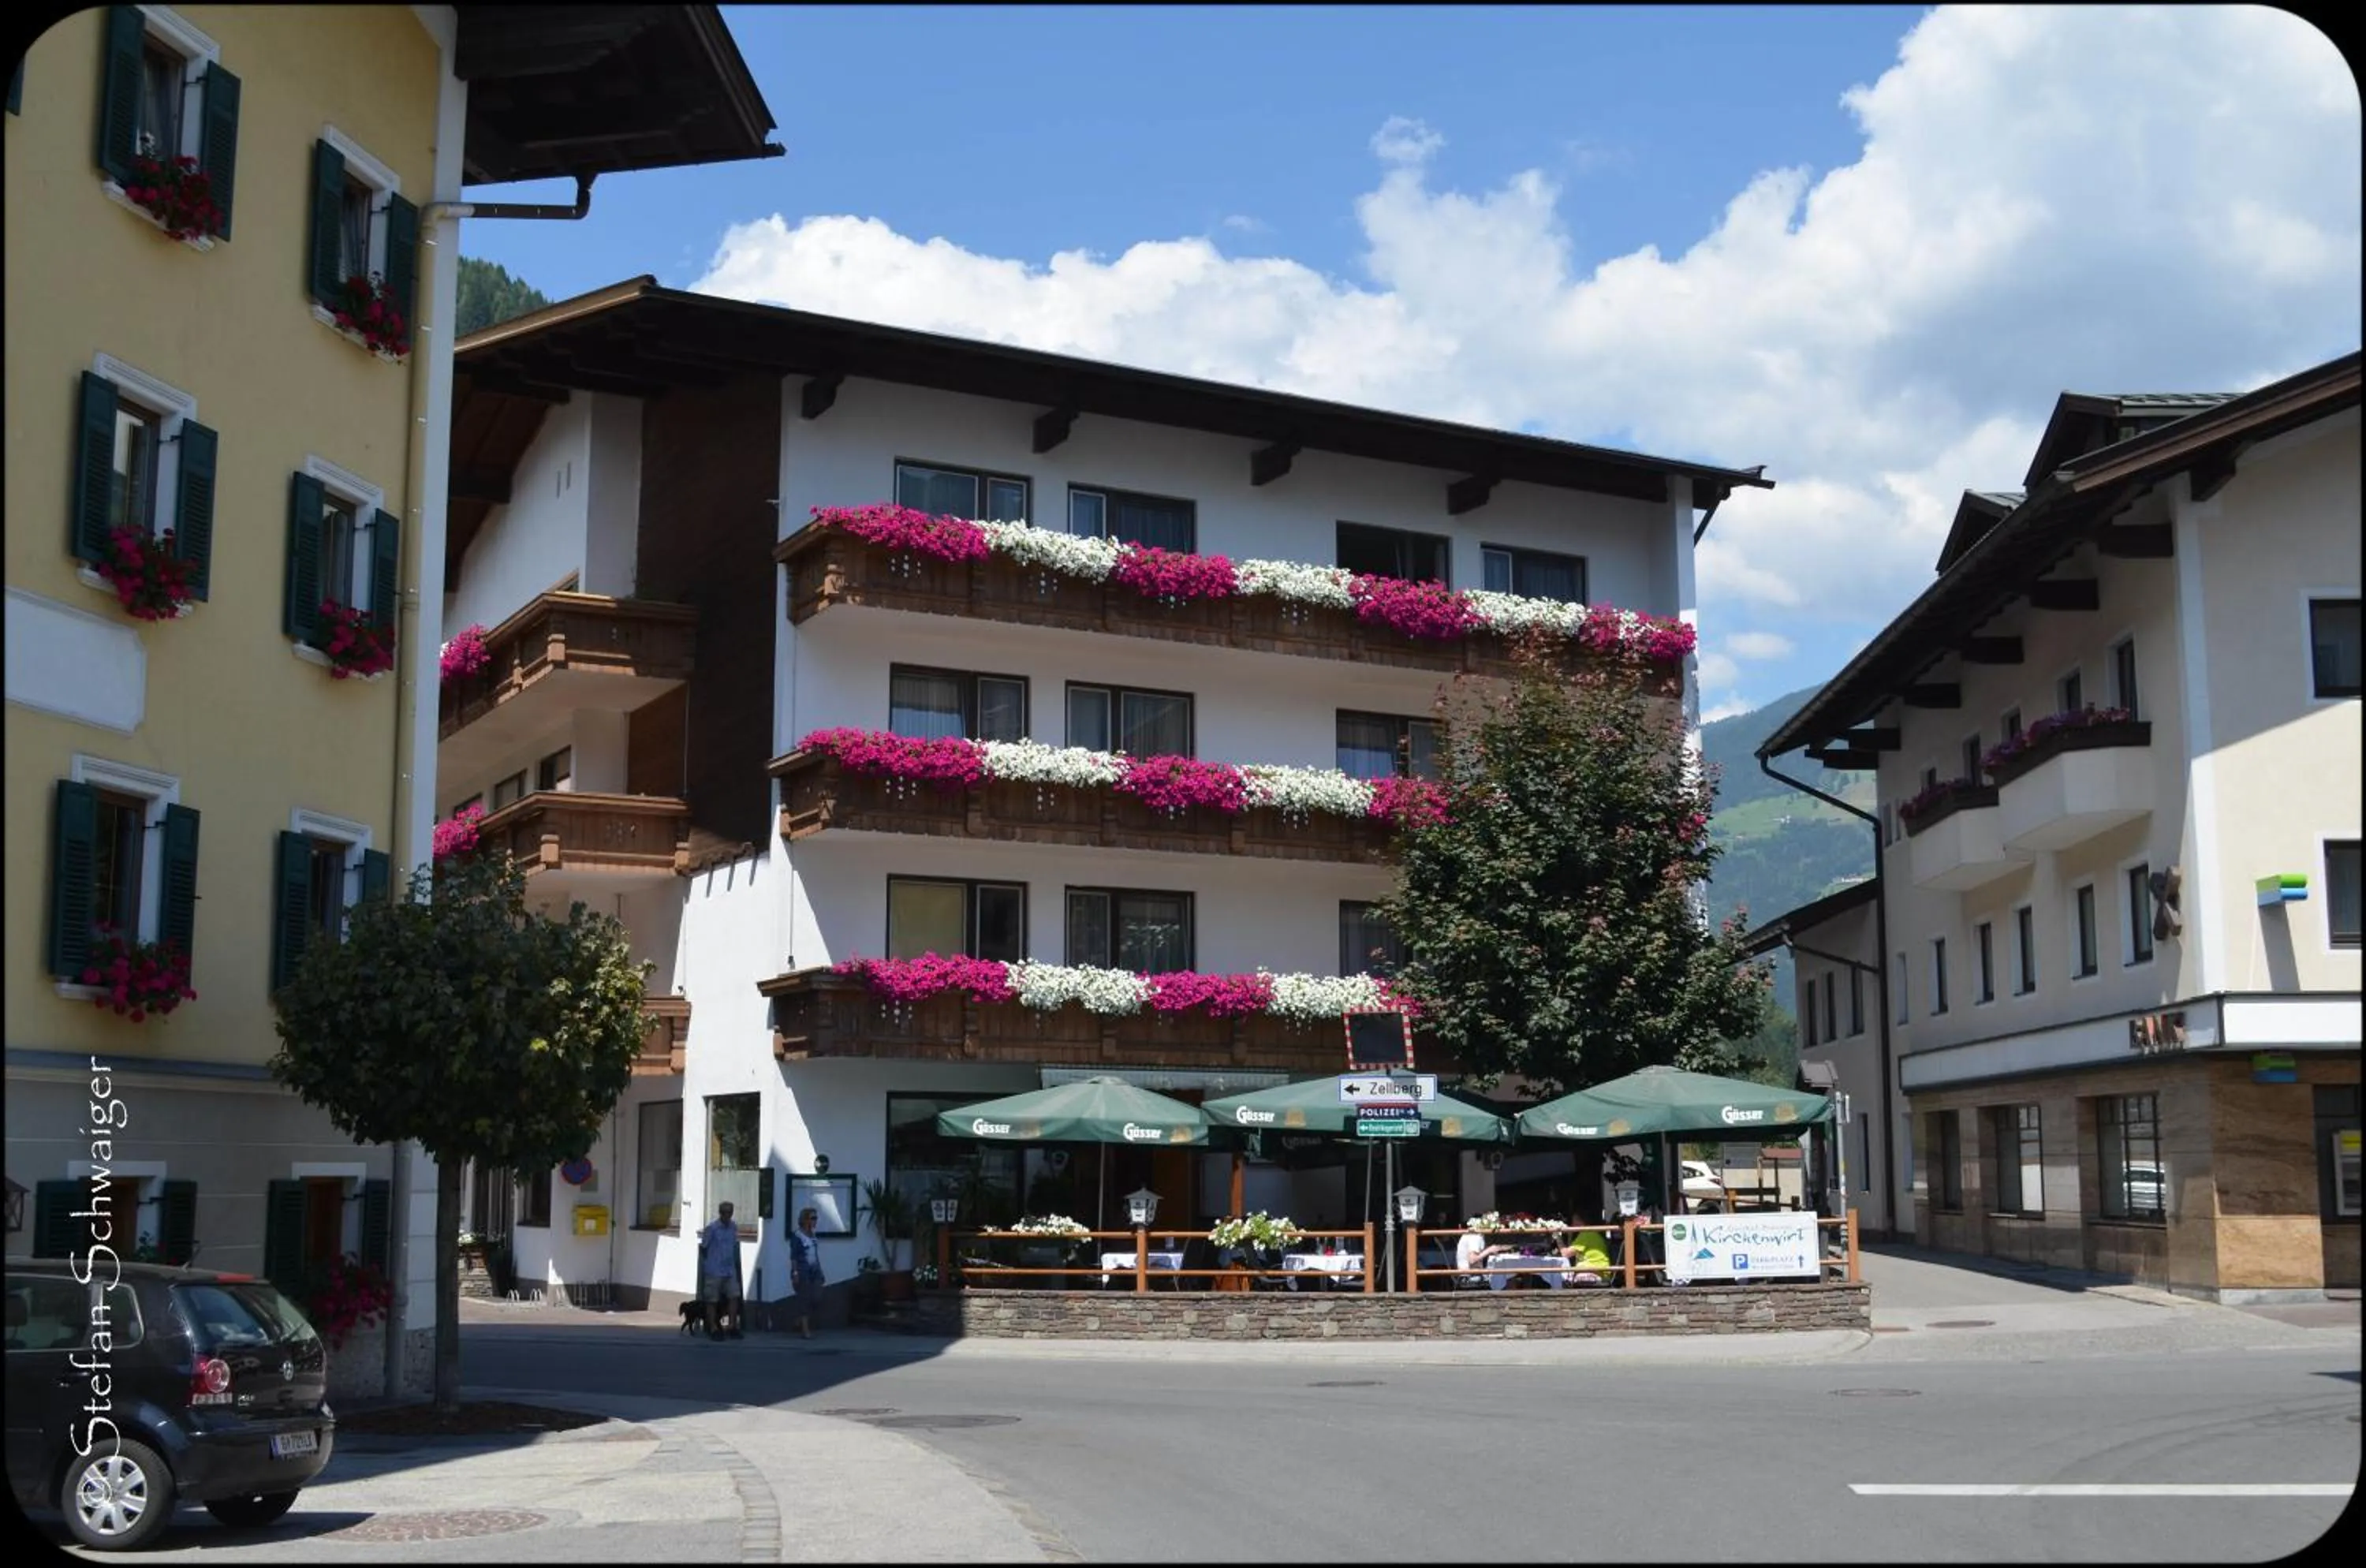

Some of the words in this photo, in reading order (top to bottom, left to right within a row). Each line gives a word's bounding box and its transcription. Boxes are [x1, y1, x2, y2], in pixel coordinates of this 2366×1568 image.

[1369, 1081, 1423, 1098] Zellberg
[1236, 1105, 1275, 1124] Gösser
[1359, 1107, 1400, 1117] POLIZEI
[1722, 1105, 1763, 1124] Gösser
[972, 1118, 1010, 1136] Gösser
[1123, 1122, 1162, 1141] Gösser
[1703, 1226, 1805, 1246] Kirchenwirt
[1734, 1255, 1747, 1269] P
